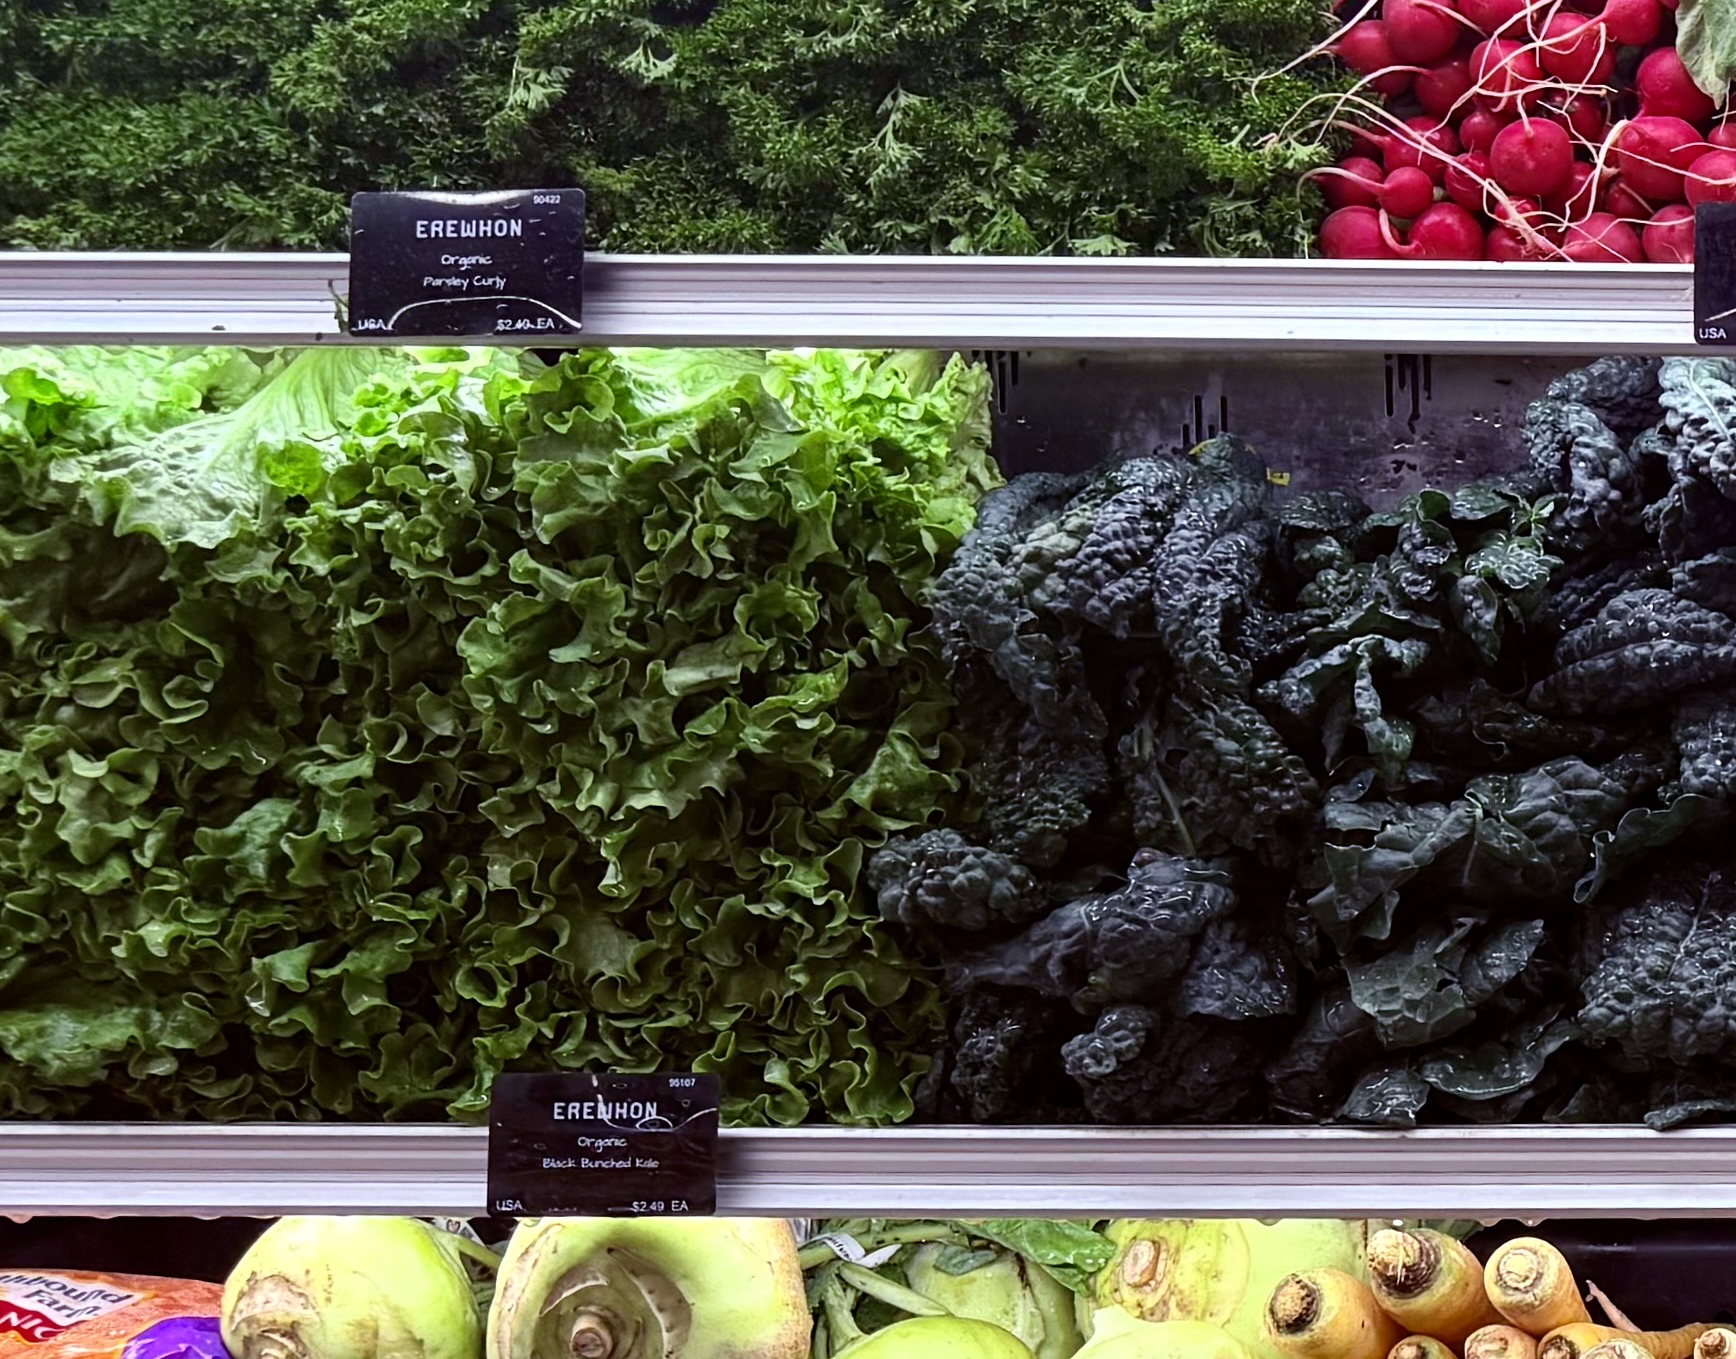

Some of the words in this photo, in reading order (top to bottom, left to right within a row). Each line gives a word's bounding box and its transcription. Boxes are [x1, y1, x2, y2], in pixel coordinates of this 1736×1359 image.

[417, 220, 522, 238] EREWHON
[441, 254, 492, 270] Organic
[424, 277, 469, 290] Parsley
[473, 276, 506, 289] Curly
[537, 318, 554, 329] EA
[1700, 329, 1726, 339] USA
[578, 1137, 627, 1152] Organic
[543, 1158, 575, 1168] Black
[581, 1158, 631, 1168] Bunched
[636, 1159, 659, 1168] Kale
[496, 1200, 522, 1211] USA
[632, 1201, 664, 1212] $2.49
[671, 1201, 688, 1211] EA
